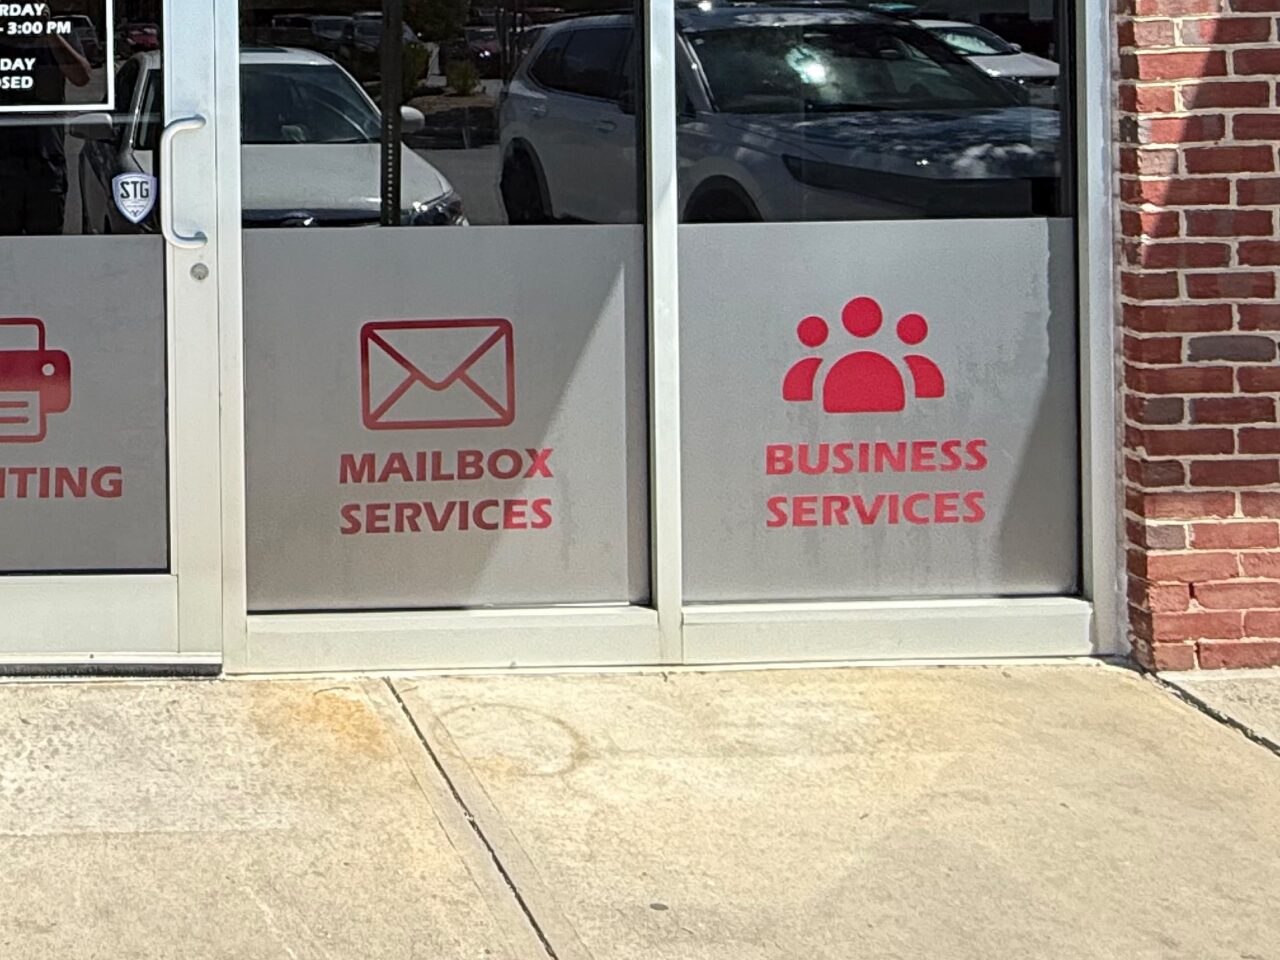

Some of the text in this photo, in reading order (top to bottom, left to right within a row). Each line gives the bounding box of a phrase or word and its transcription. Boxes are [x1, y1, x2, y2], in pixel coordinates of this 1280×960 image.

[7, 21, 43, 35] 3:00
[46, 21, 71, 34] PM
[120, 180, 150, 199] STG
[339, 448, 554, 484] MAILBOX
[766, 439, 988, 475] BUSINESS
[339, 498, 553, 535] SERVICES
[766, 491, 987, 528] SERVICES
